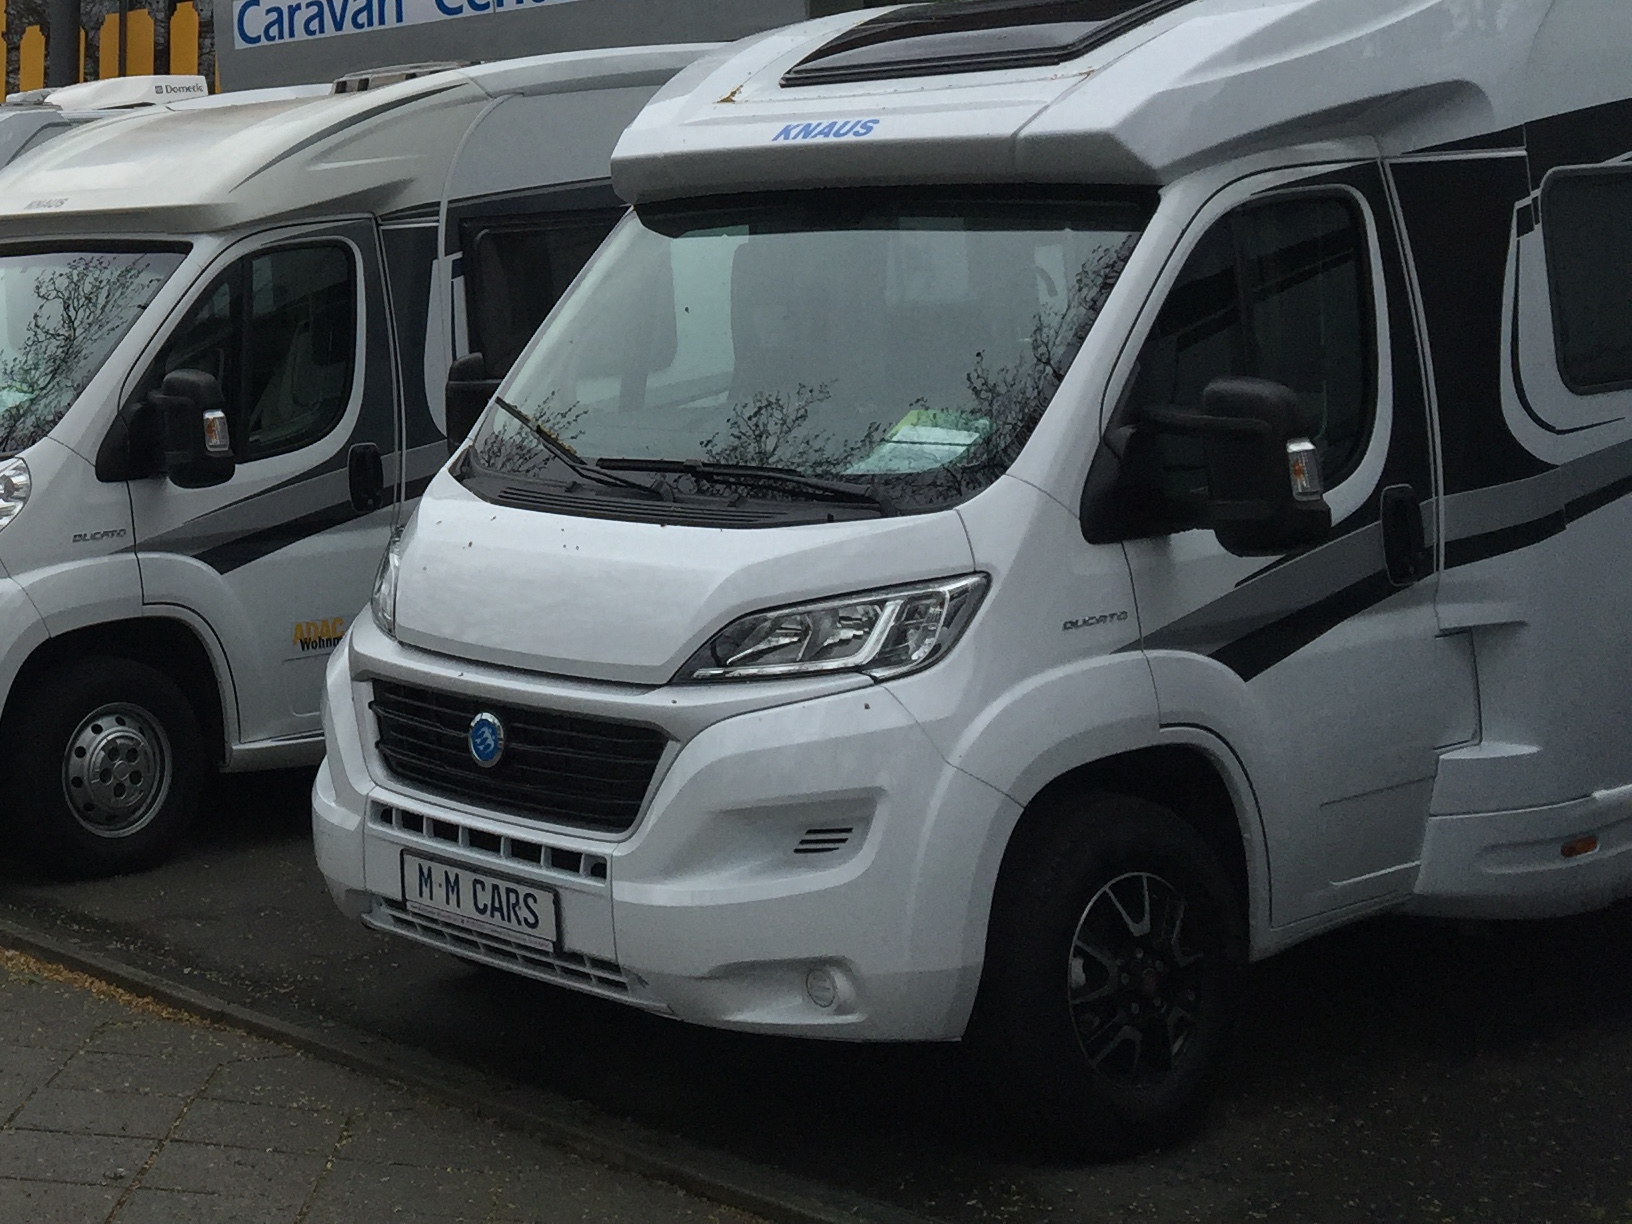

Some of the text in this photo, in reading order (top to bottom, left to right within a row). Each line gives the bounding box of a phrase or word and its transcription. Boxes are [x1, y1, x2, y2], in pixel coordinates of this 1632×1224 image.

[164, 83, 204, 94] Dometic
[771, 119, 881, 141] KNAUS
[73, 529, 127, 543] DUCATO
[293, 617, 345, 645] ADAC
[1062, 611, 1128, 631] DUCATO
[472, 878, 540, 930] CARS
